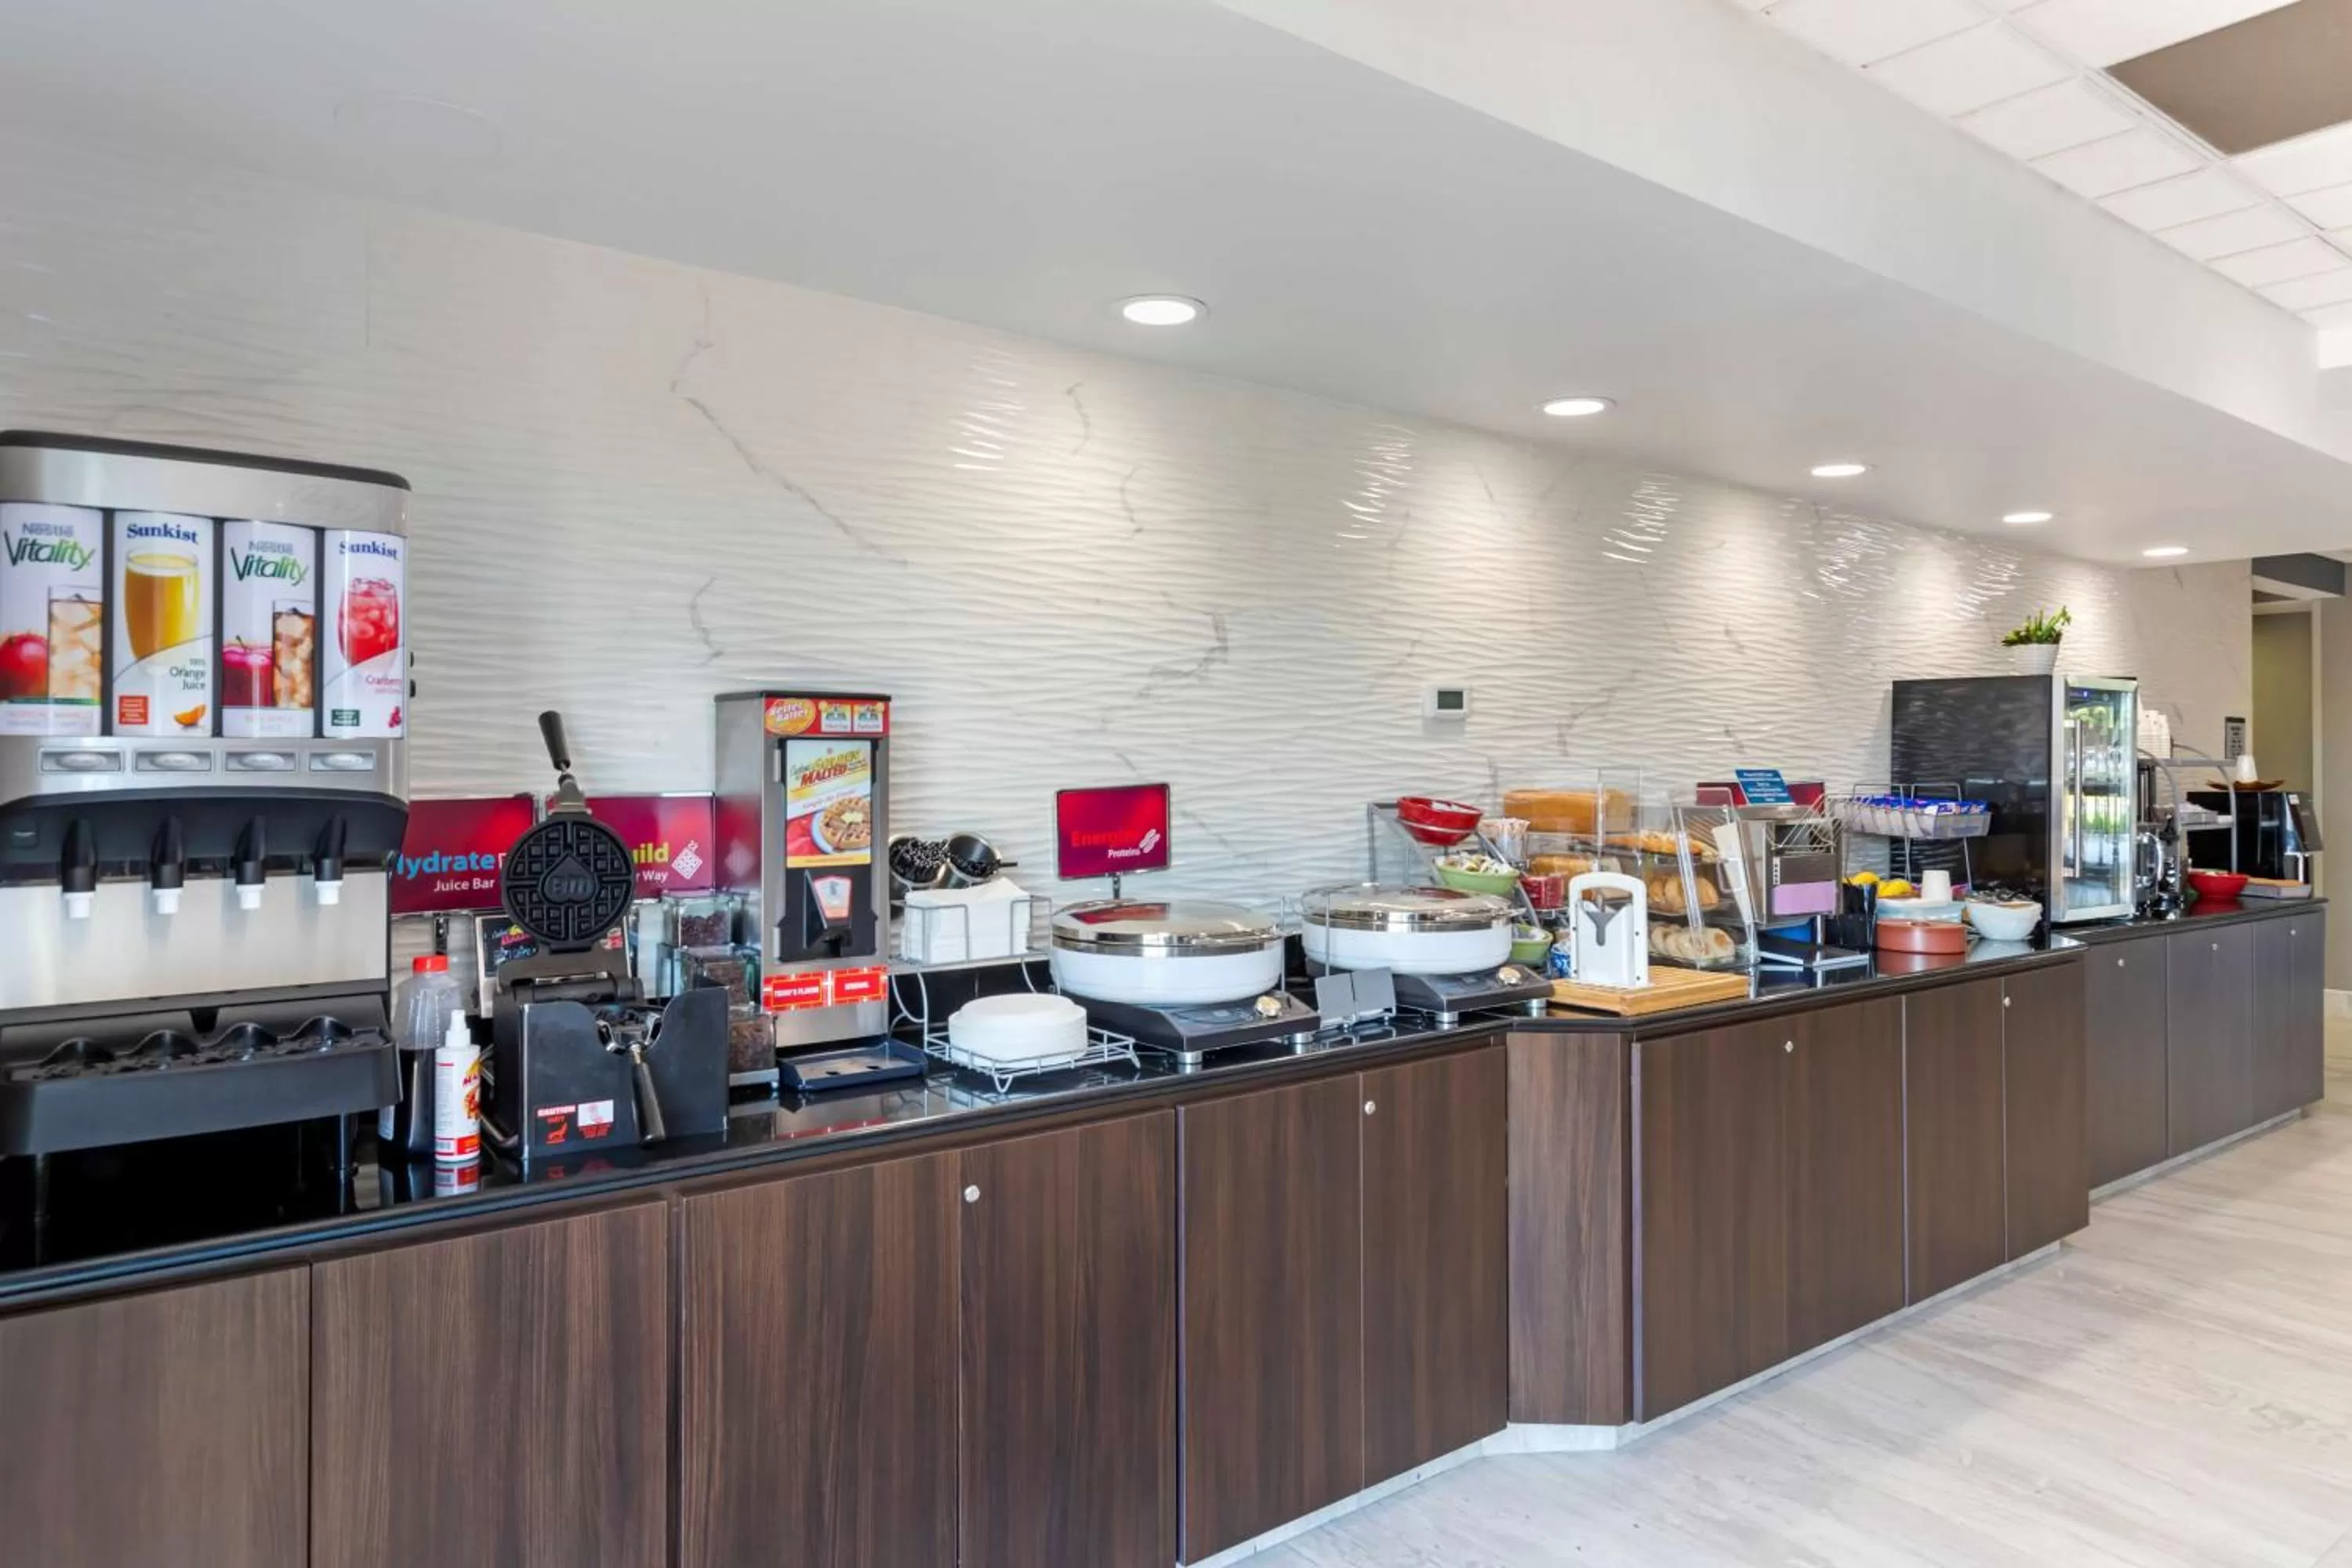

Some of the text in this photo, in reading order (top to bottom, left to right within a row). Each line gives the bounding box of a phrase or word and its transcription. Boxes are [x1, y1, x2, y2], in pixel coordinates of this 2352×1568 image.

[127, 523, 198, 544] Sunkist
[5, 530, 96, 572] Vitality
[339, 541, 398, 561] Sunkist
[230, 547, 310, 586] Vitality
[169, 666, 205, 681] Orange
[183, 680, 205, 691] Juice
[632, 842, 669, 864] ild
[1107, 847, 1141, 859] Proteins
[434, 877, 495, 891] Juice Bar
[643, 869, 669, 884] Way
